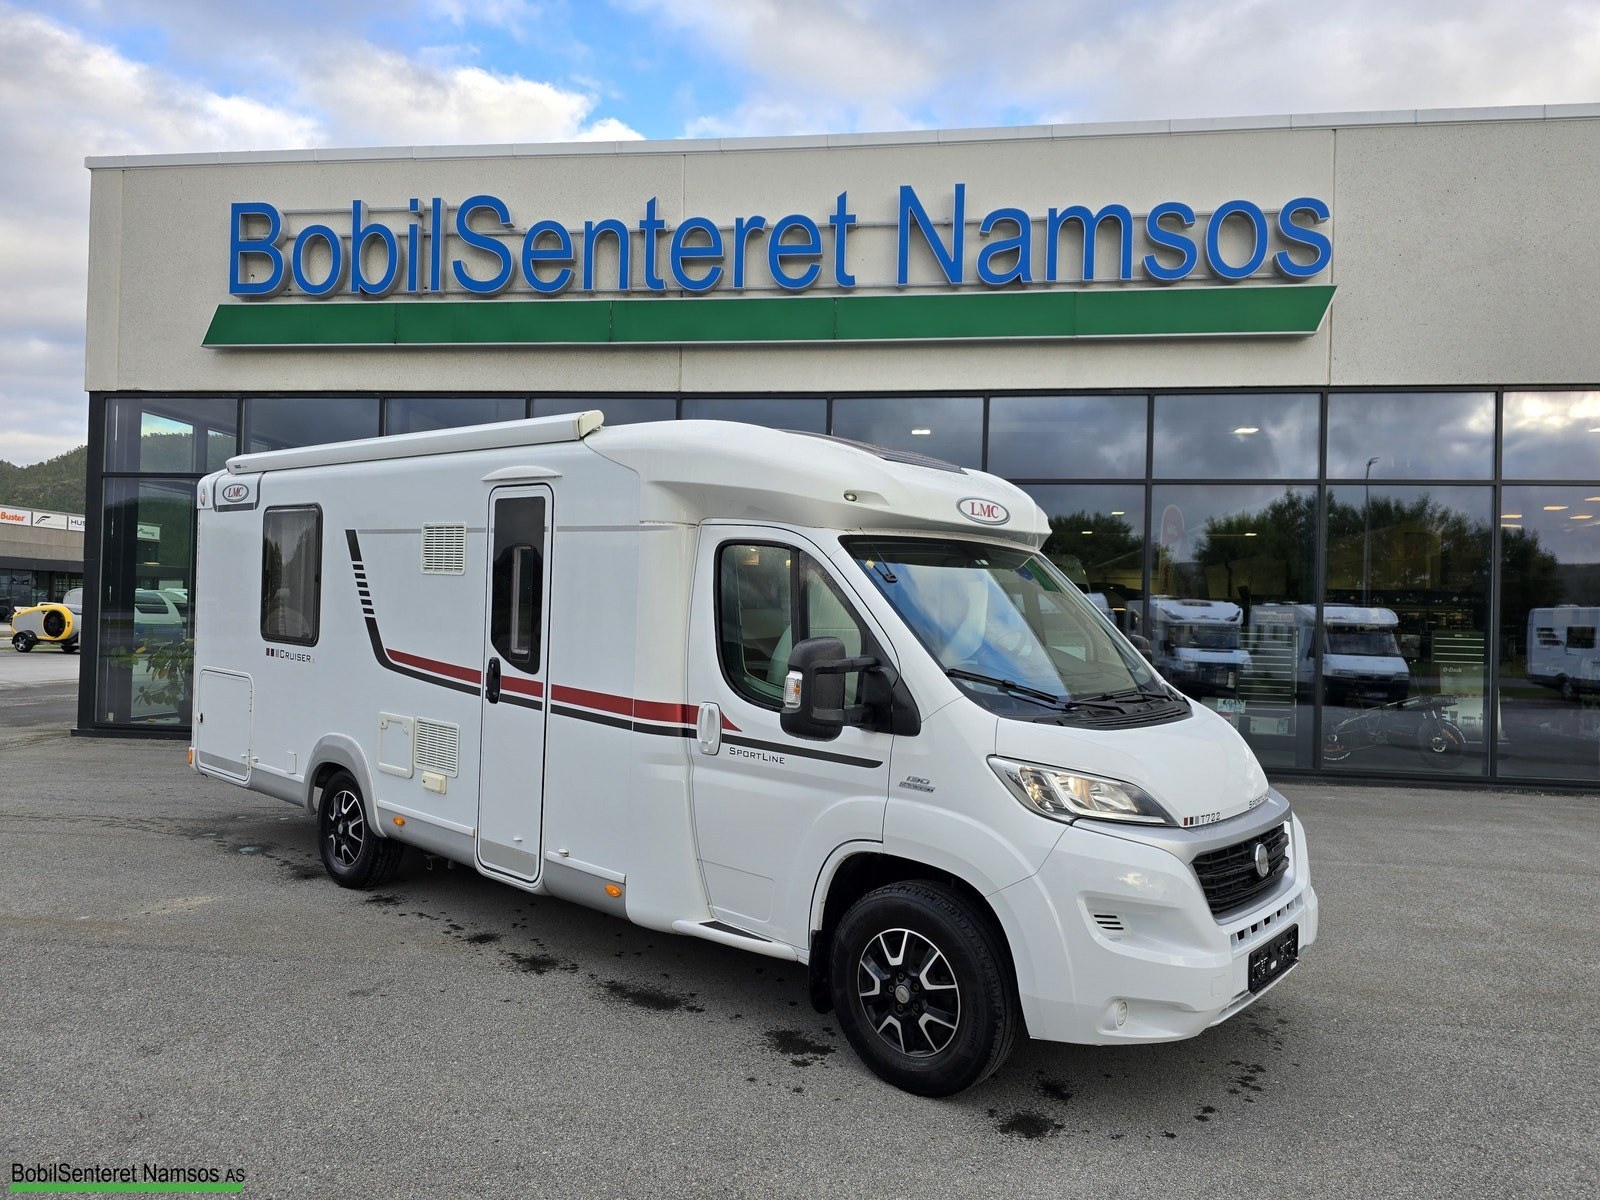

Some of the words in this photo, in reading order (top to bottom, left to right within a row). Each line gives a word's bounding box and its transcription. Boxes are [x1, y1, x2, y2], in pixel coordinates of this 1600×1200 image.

[228, 190, 858, 298] BobilSenteret
[897, 182, 1333, 288] Namsos
[227, 487, 244, 498] LMC
[0, 511, 26, 522] Buster
[969, 501, 1000, 519] LMC
[1200, 811, 1221, 824] T722
